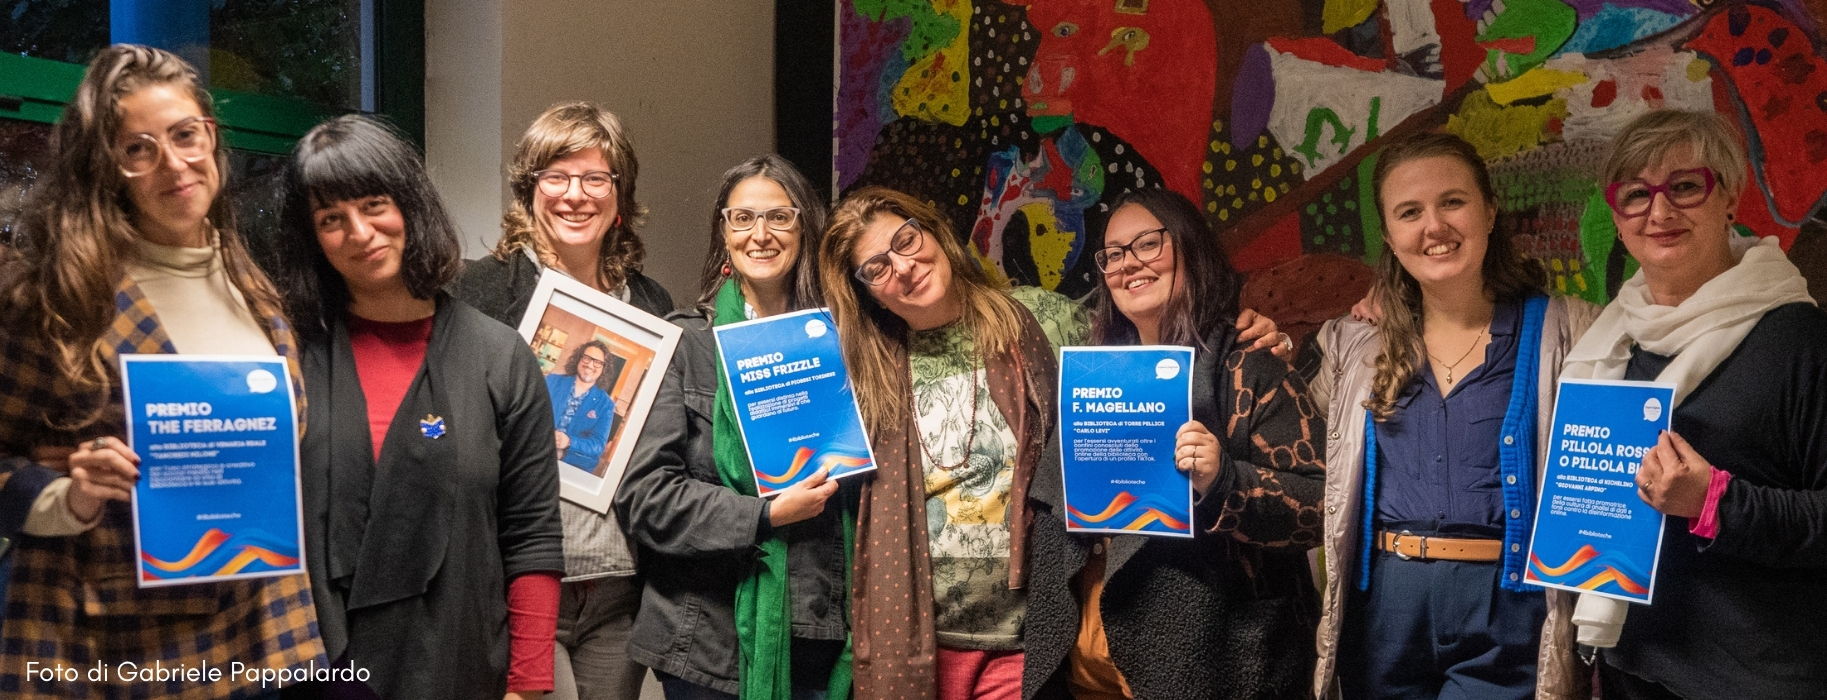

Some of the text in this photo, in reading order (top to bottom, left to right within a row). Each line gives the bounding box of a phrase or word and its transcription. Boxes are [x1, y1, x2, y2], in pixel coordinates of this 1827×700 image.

[737, 352, 783, 370] PREMIO
[740, 357, 820, 383] MISS FRIZZLE
[754, 382, 785, 393] BIBLIOTECA
[791, 377, 811, 385] PIOBESI
[1072, 388, 1122, 398] PREMIO
[146, 402, 212, 417] PREMIO
[1072, 402, 1166, 412] F. MAGELLANO
[148, 417, 277, 434] THE FERRAGNEZ
[1564, 424, 1610, 438] PREMIO
[1561, 440, 1650, 458] PILLOLA ROSS
[1560, 455, 1569, 466] O
[1572, 456, 1624, 474] PILLOLA
[1567, 475, 1598, 484] BIBLIOTECA
[1604, 479, 1633, 487] NICHELINO
